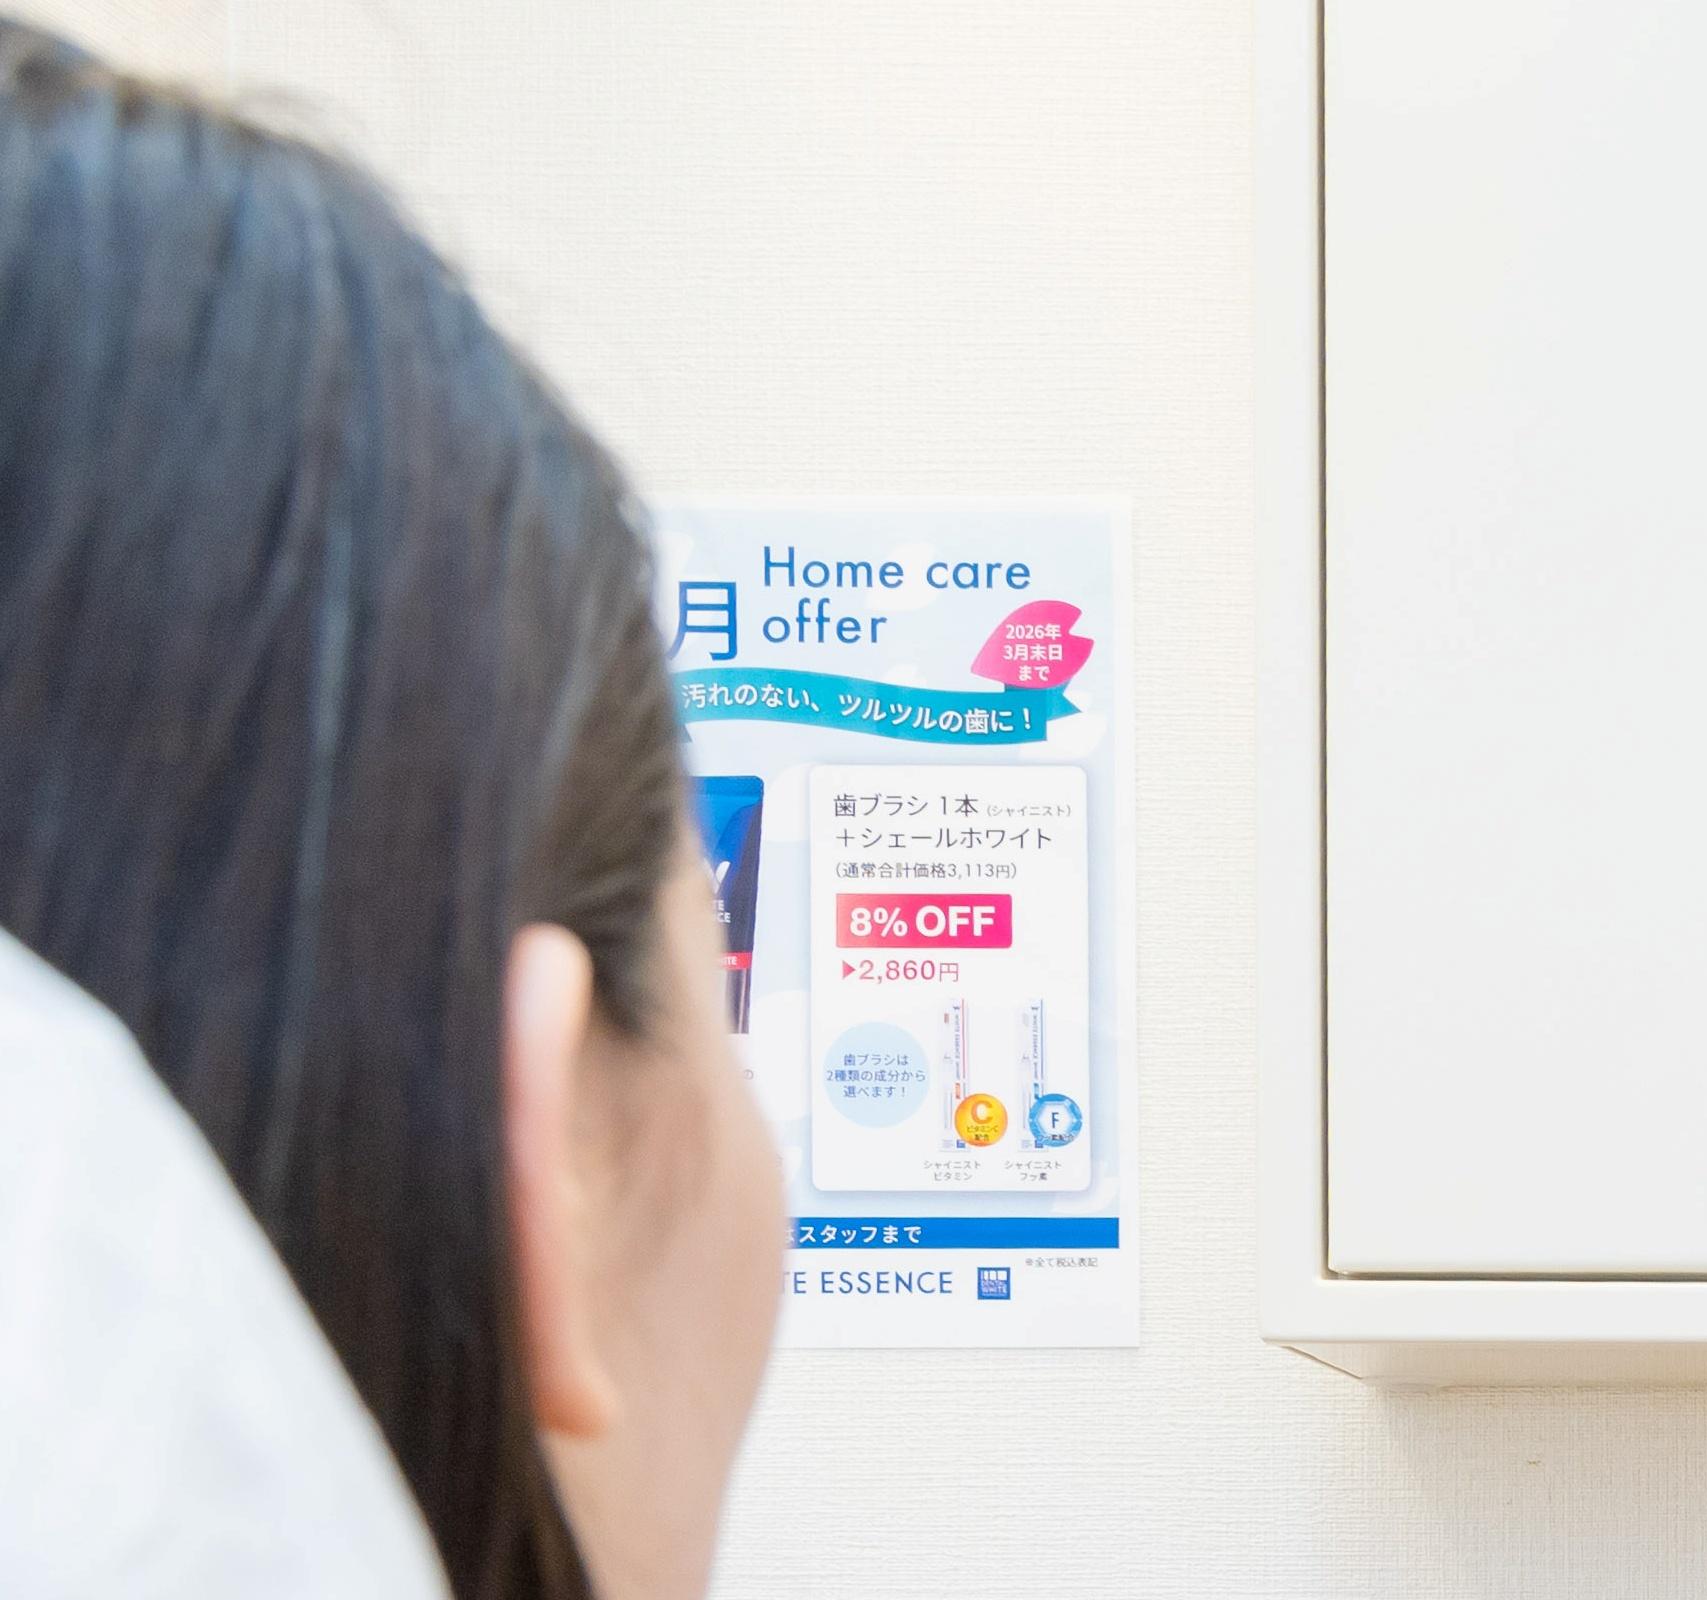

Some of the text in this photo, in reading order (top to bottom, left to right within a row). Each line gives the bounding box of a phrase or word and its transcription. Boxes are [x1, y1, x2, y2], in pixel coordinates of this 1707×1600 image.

[762, 545, 1032, 590] Home care
[668, 580, 739, 661] 月
[762, 597, 888, 644] offer
[1004, 623, 1062, 641] 2026年
[1002, 642, 1063, 662] 3月末日
[1017, 664, 1050, 682] まで
[848, 905, 996, 938] 8% OFF
[857, 959, 960, 984] 2,860円
[842, 1053, 910, 1069] 歯ブラシは
[825, 1069, 928, 1085] 2種類の成分から
[842, 1085, 908, 1100] 選べます！
[1051, 1112, 1060, 1129] F
[820, 1270, 954, 1295] ESSENCE
